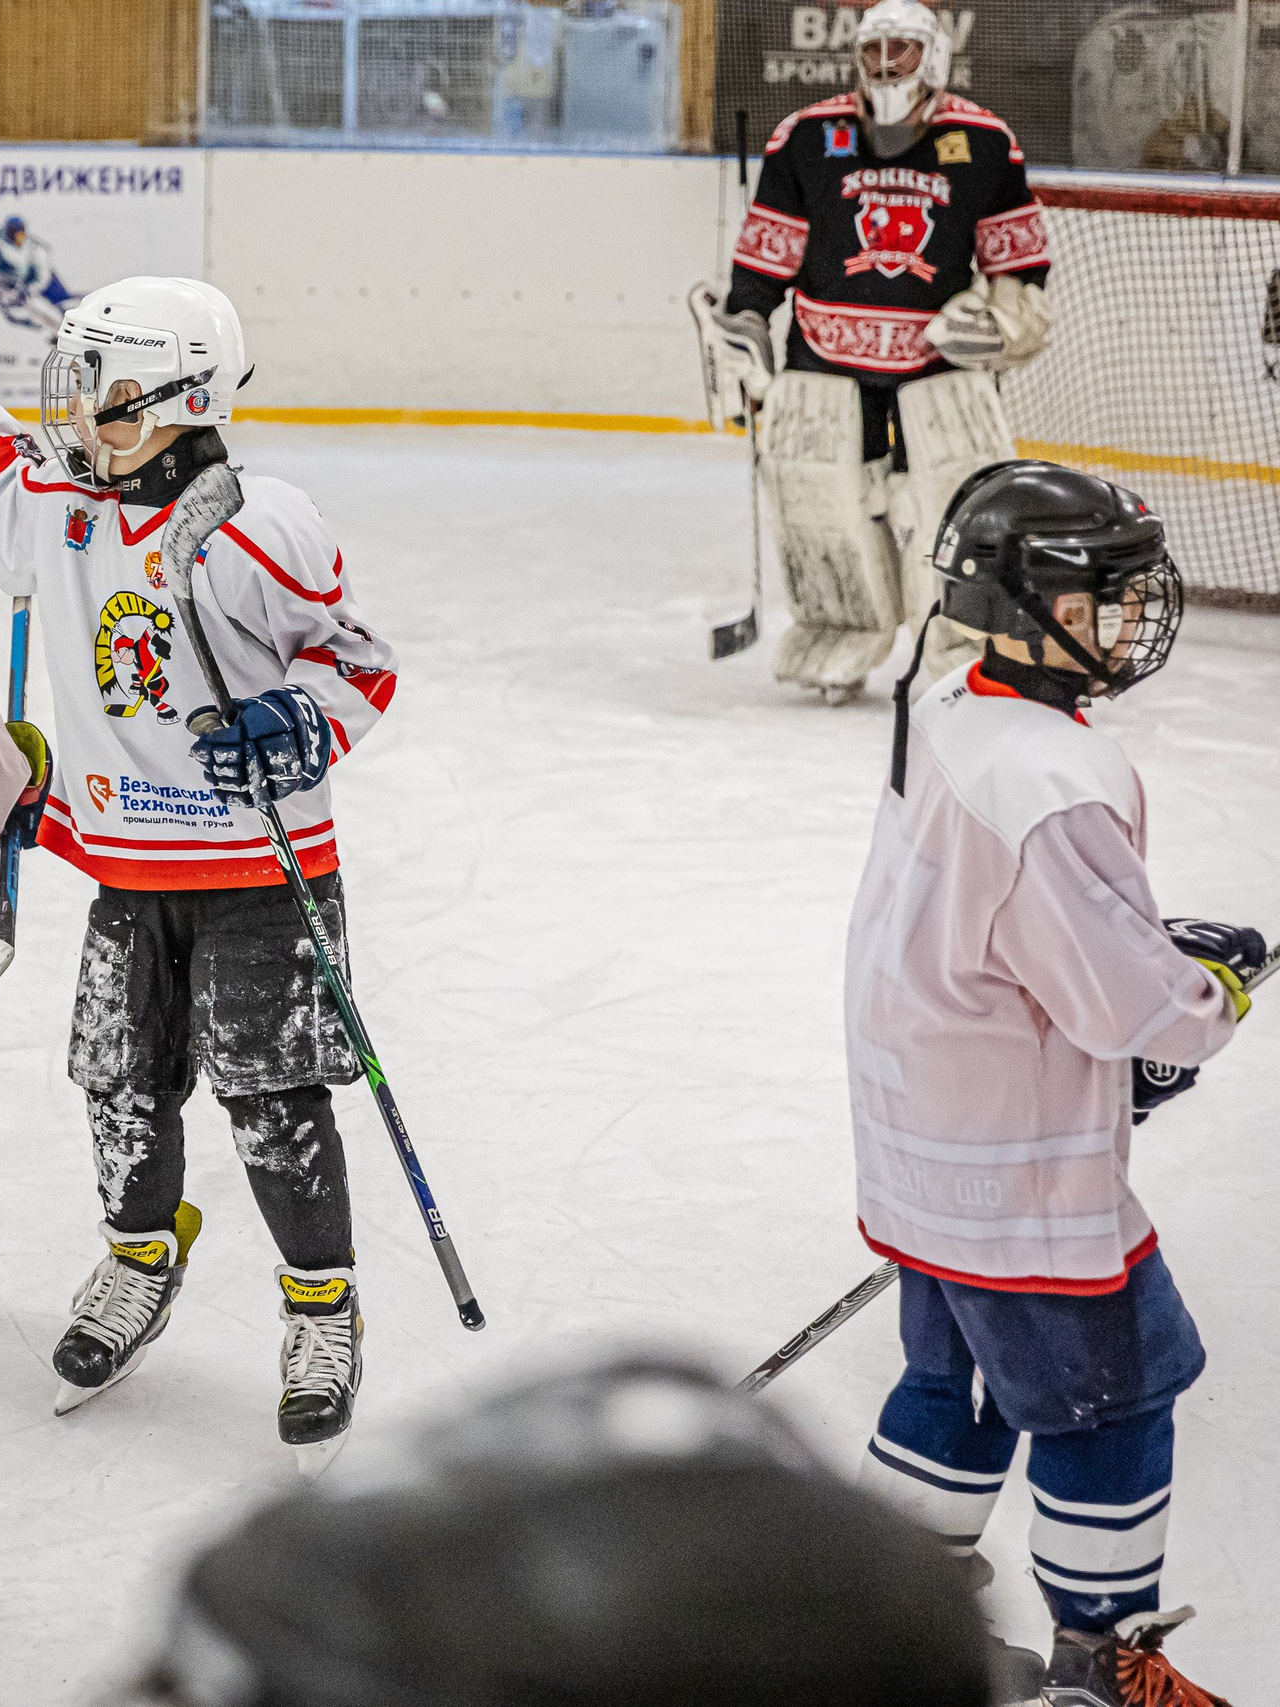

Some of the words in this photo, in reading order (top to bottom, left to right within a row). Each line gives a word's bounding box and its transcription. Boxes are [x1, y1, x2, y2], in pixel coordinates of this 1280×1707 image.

[113, 334, 166, 348] BAUER
[127, 391, 162, 412] BAUE
[120, 776, 215, 802] Безопасны
[120, 795, 230, 818] Технологии
[123, 816, 197, 828] промышленная
[310, 915, 337, 966] BAUER
[286, 1284, 339, 1298] BAUER
